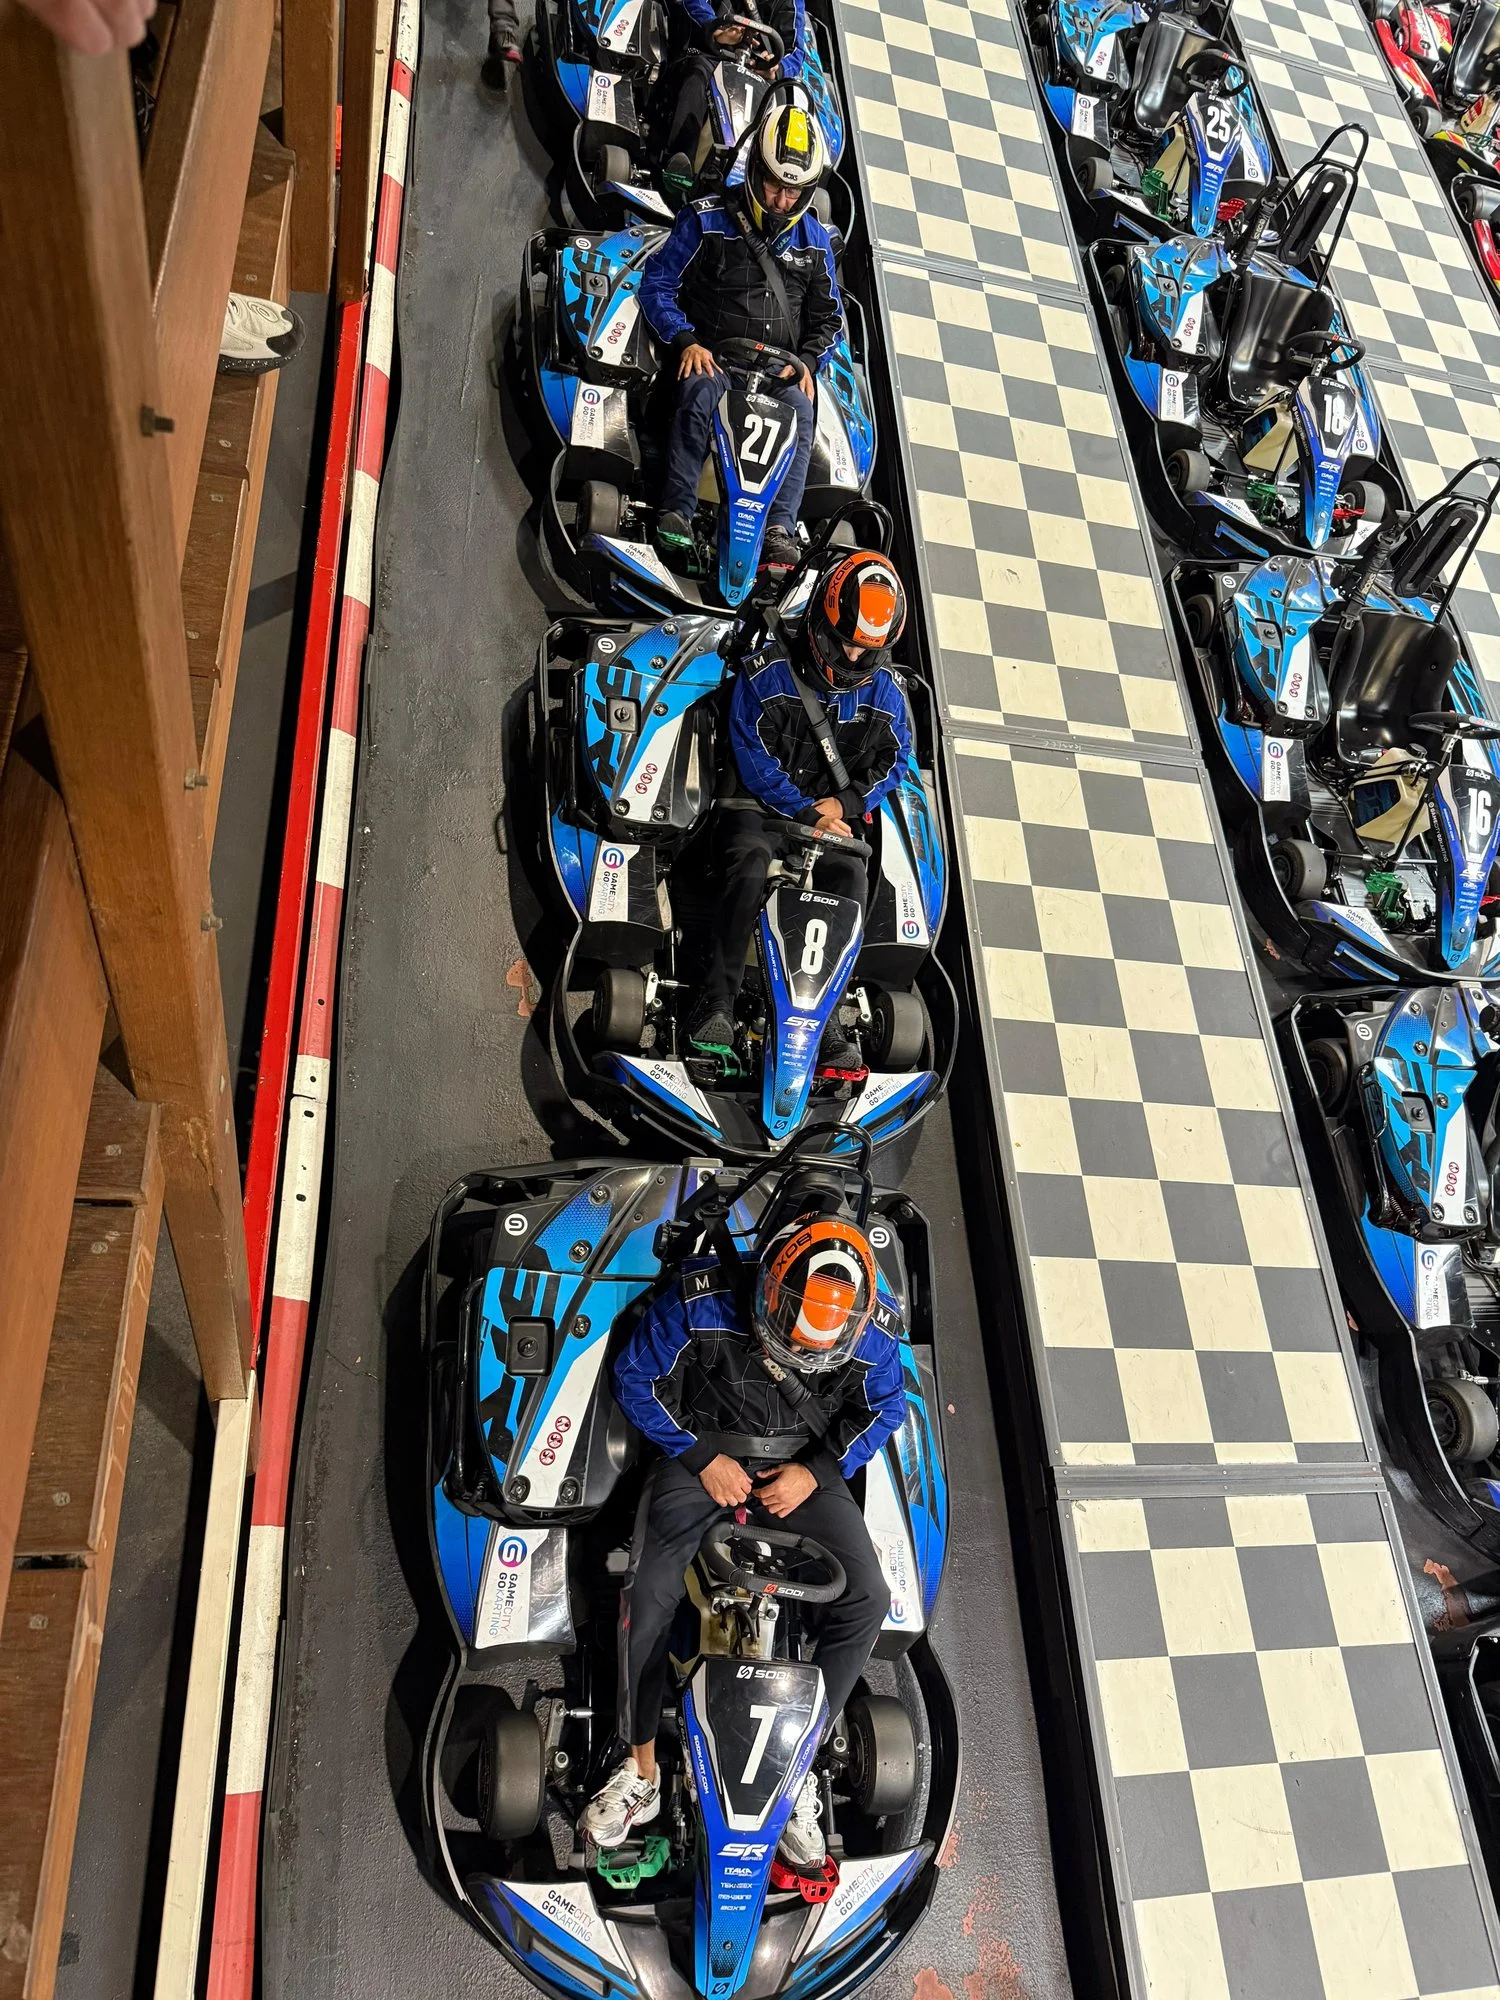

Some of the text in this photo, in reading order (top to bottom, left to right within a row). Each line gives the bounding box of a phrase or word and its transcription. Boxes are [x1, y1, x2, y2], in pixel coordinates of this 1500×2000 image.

[1206, 105, 1231, 142] 25
[698, 200, 714, 209] XL
[756, 397, 778, 409] SODI
[1324, 393, 1346, 436] 18
[740, 413, 781, 466] 27
[733, 498, 765, 512] SR
[752, 655, 766, 669] M
[1468, 787, 1492, 836] 16
[823, 833, 843, 843] SODI
[598, 871, 611, 915] GOKARTING
[608, 872, 619, 913] GAMECITY
[813, 895, 840, 907] SODI
[801, 918, 828, 975] 8
[783, 1016, 821, 1031] SR
[650, 1069, 688, 1099] GOKARTING
[654, 1064, 689, 1091] GAMECITY
[864, 1076, 895, 1100] GAMECITY
[695, 1274, 710, 1291] M
[876, 1308, 889, 1326] M
[489, 1572, 507, 1636] GOKARTING
[501, 1573, 518, 1631] GAMECITY
[776, 1586, 805, 1597] SODI
[740, 1704, 778, 1785] 7
[693, 1734, 709, 1795] SODIKART.COM
[716, 1843, 769, 1858] SR
[834, 1864, 874, 1907] GAMECITY
[840, 1870, 885, 1916] GOKARTING
[541, 1900, 593, 1942] GOKARTING
[548, 1890, 595, 1927] GAMECITY
